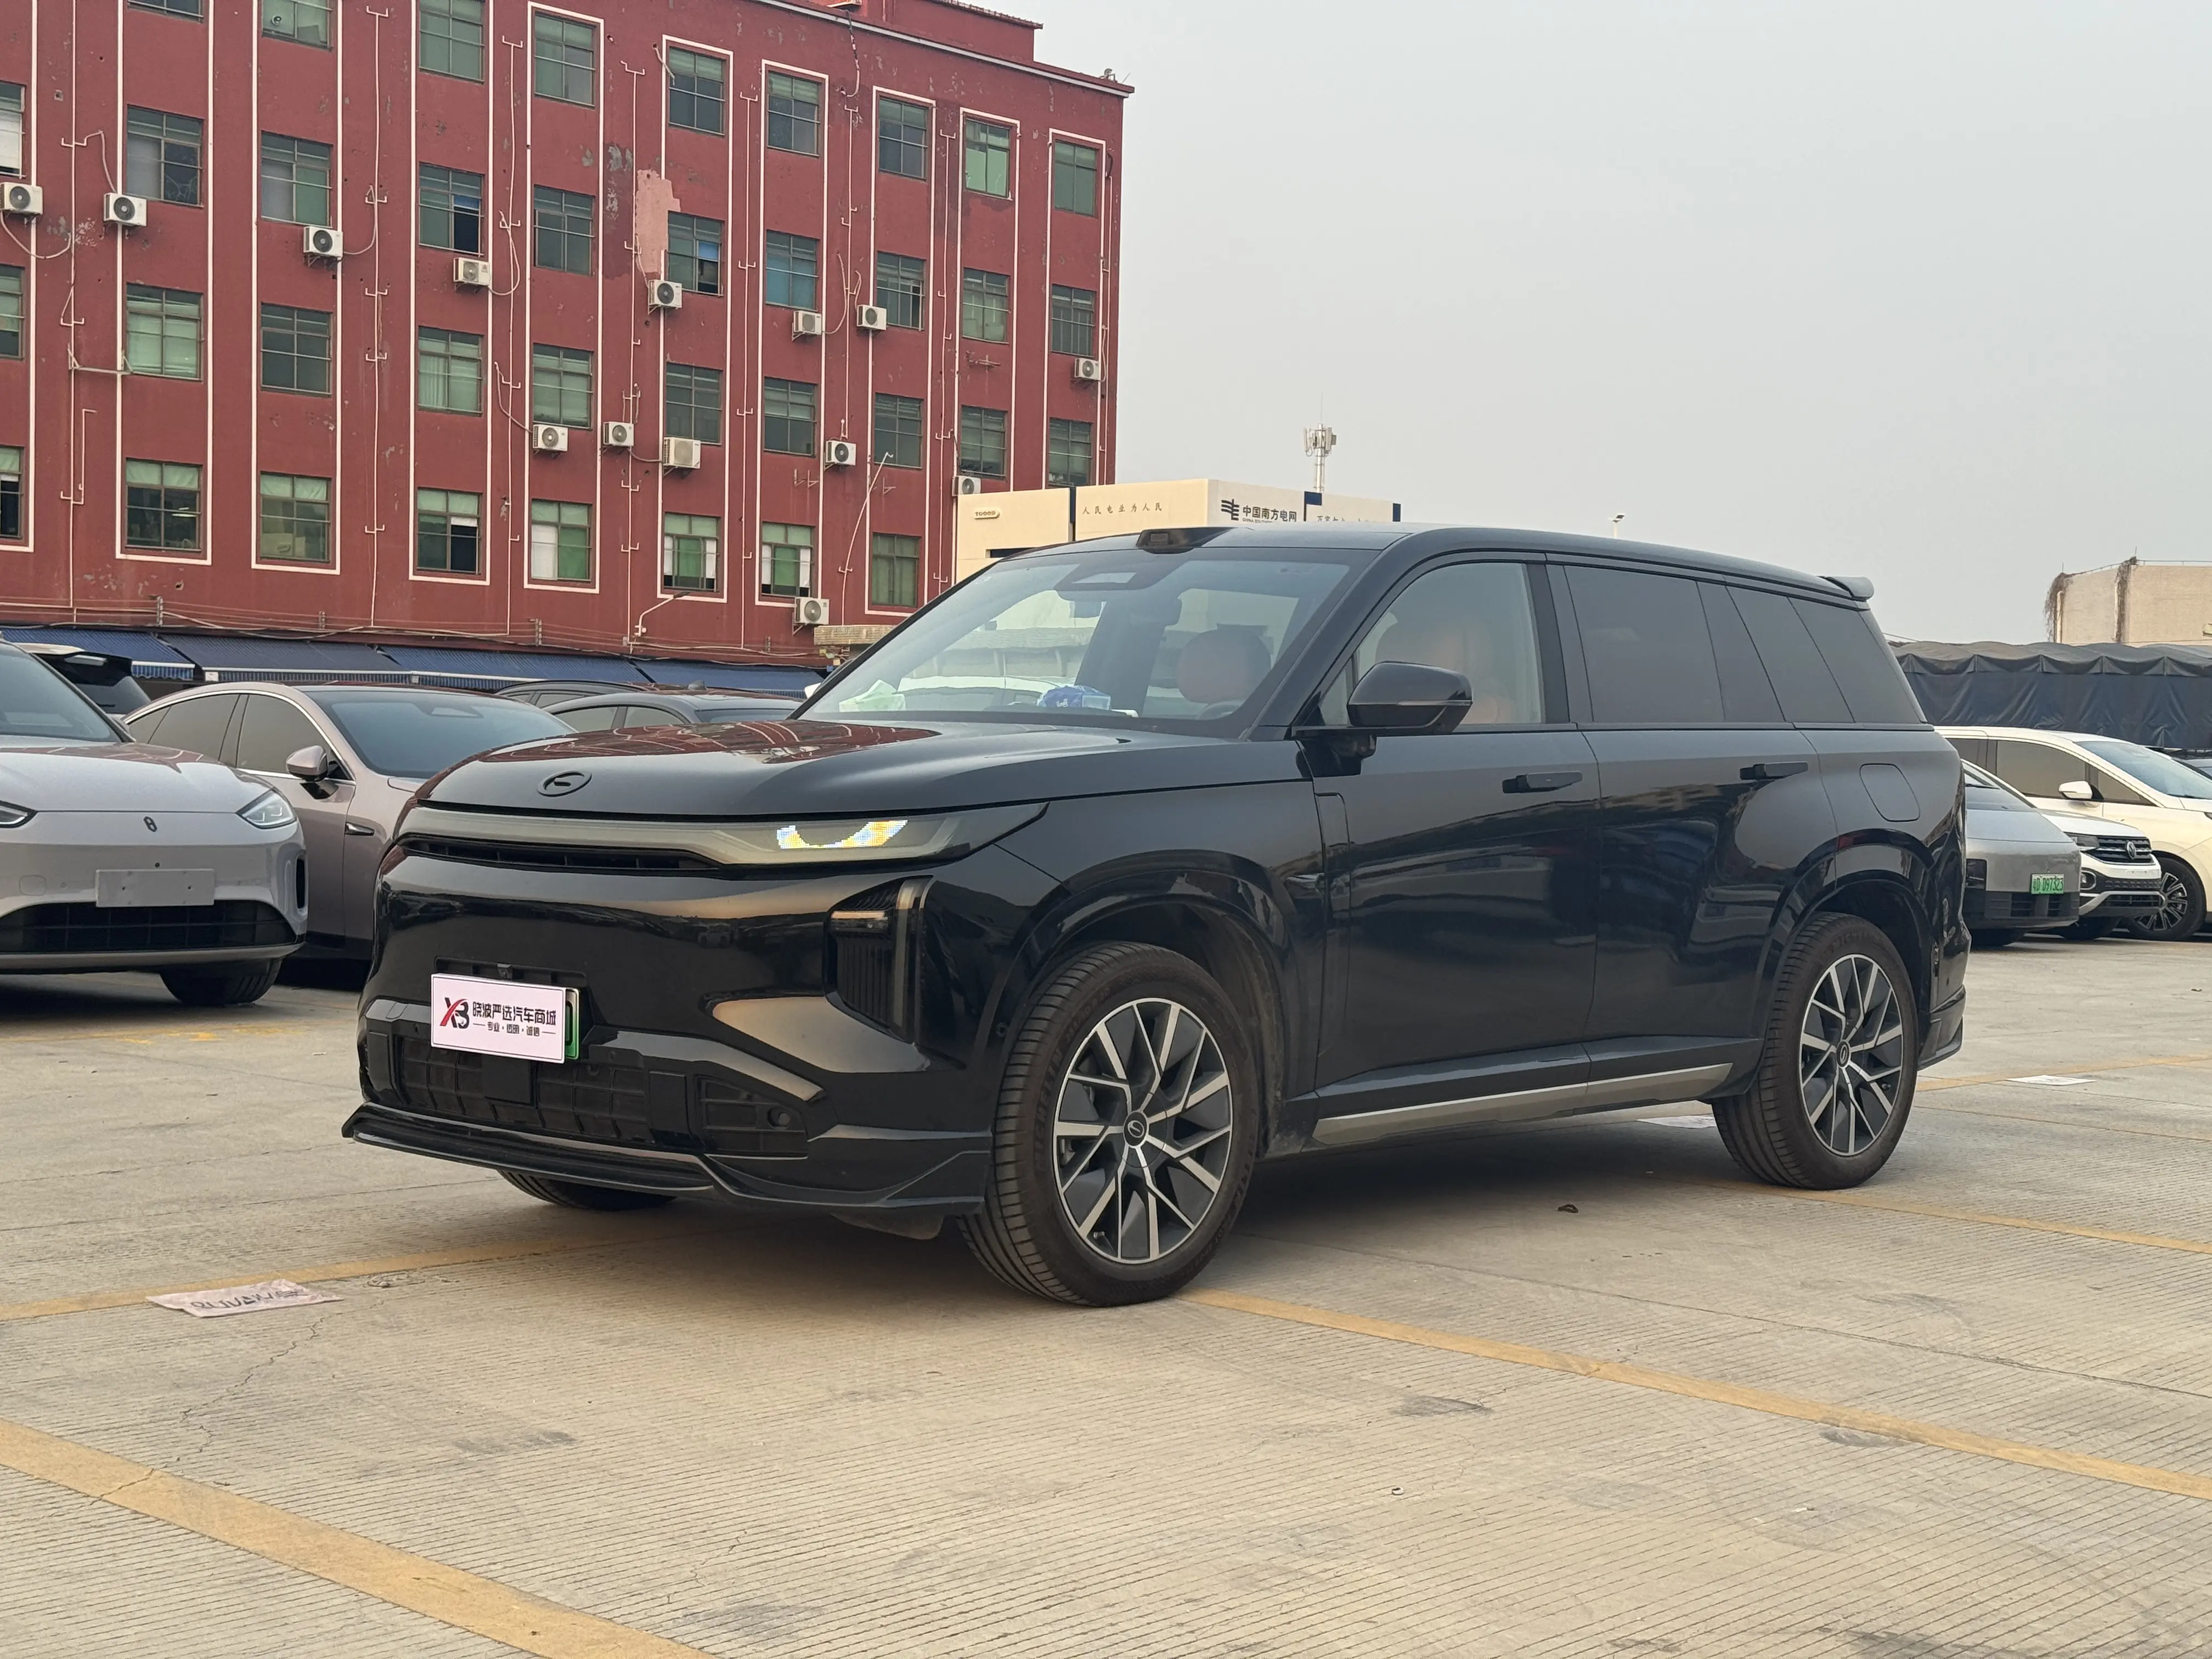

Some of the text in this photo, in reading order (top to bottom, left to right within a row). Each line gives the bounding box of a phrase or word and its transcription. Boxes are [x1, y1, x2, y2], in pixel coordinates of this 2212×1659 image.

[1082, 502, 1163, 515] 人民电业为人民
[1243, 505, 1297, 522] 中国南方电网
[472, 1001, 556, 1026] 晓波严选汽车商城
